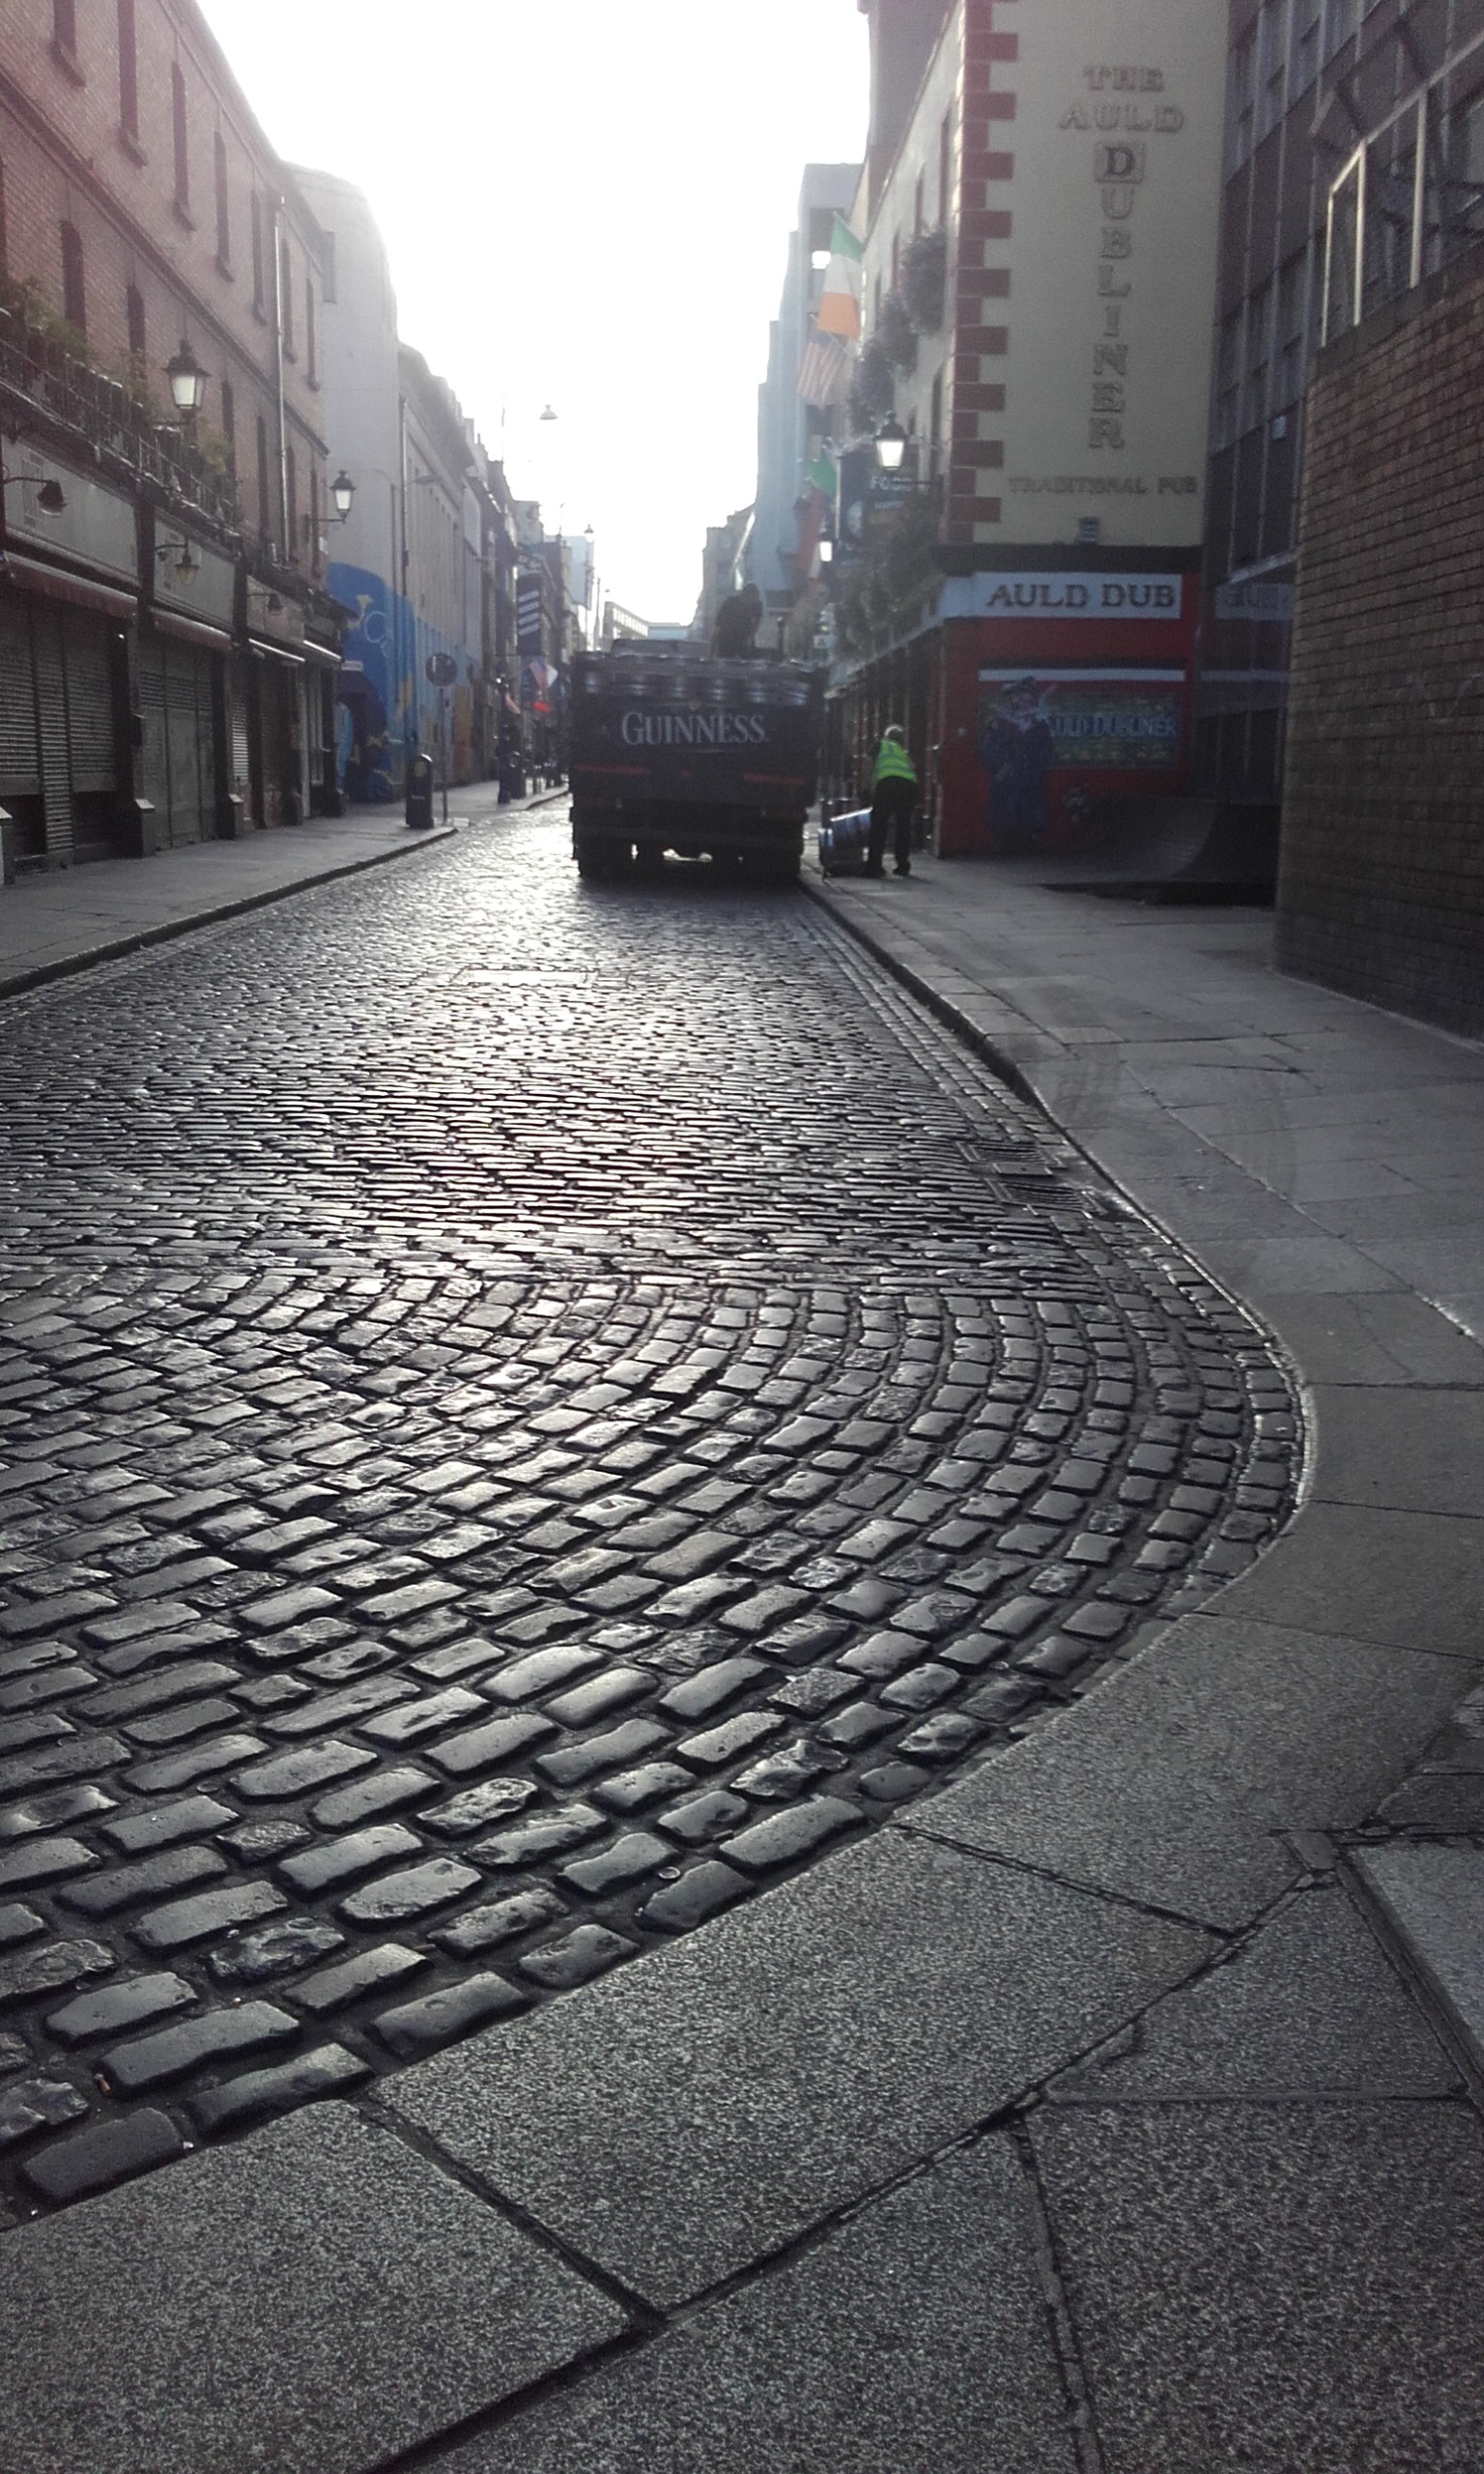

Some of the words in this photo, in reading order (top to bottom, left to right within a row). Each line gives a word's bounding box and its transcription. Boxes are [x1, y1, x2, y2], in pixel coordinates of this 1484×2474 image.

[1082, 65, 1164, 92] THE
[1058, 102, 1185, 133] AULD
[1088, 145, 1137, 450] DUBLINER
[1008, 475, 1149, 495] TRADITIONAL
[1157, 475, 1198, 495] PUB
[985, 582, 1090, 609] AULD
[1099, 583, 1177, 609] DUB
[621, 711, 767, 745] GUINNESS
